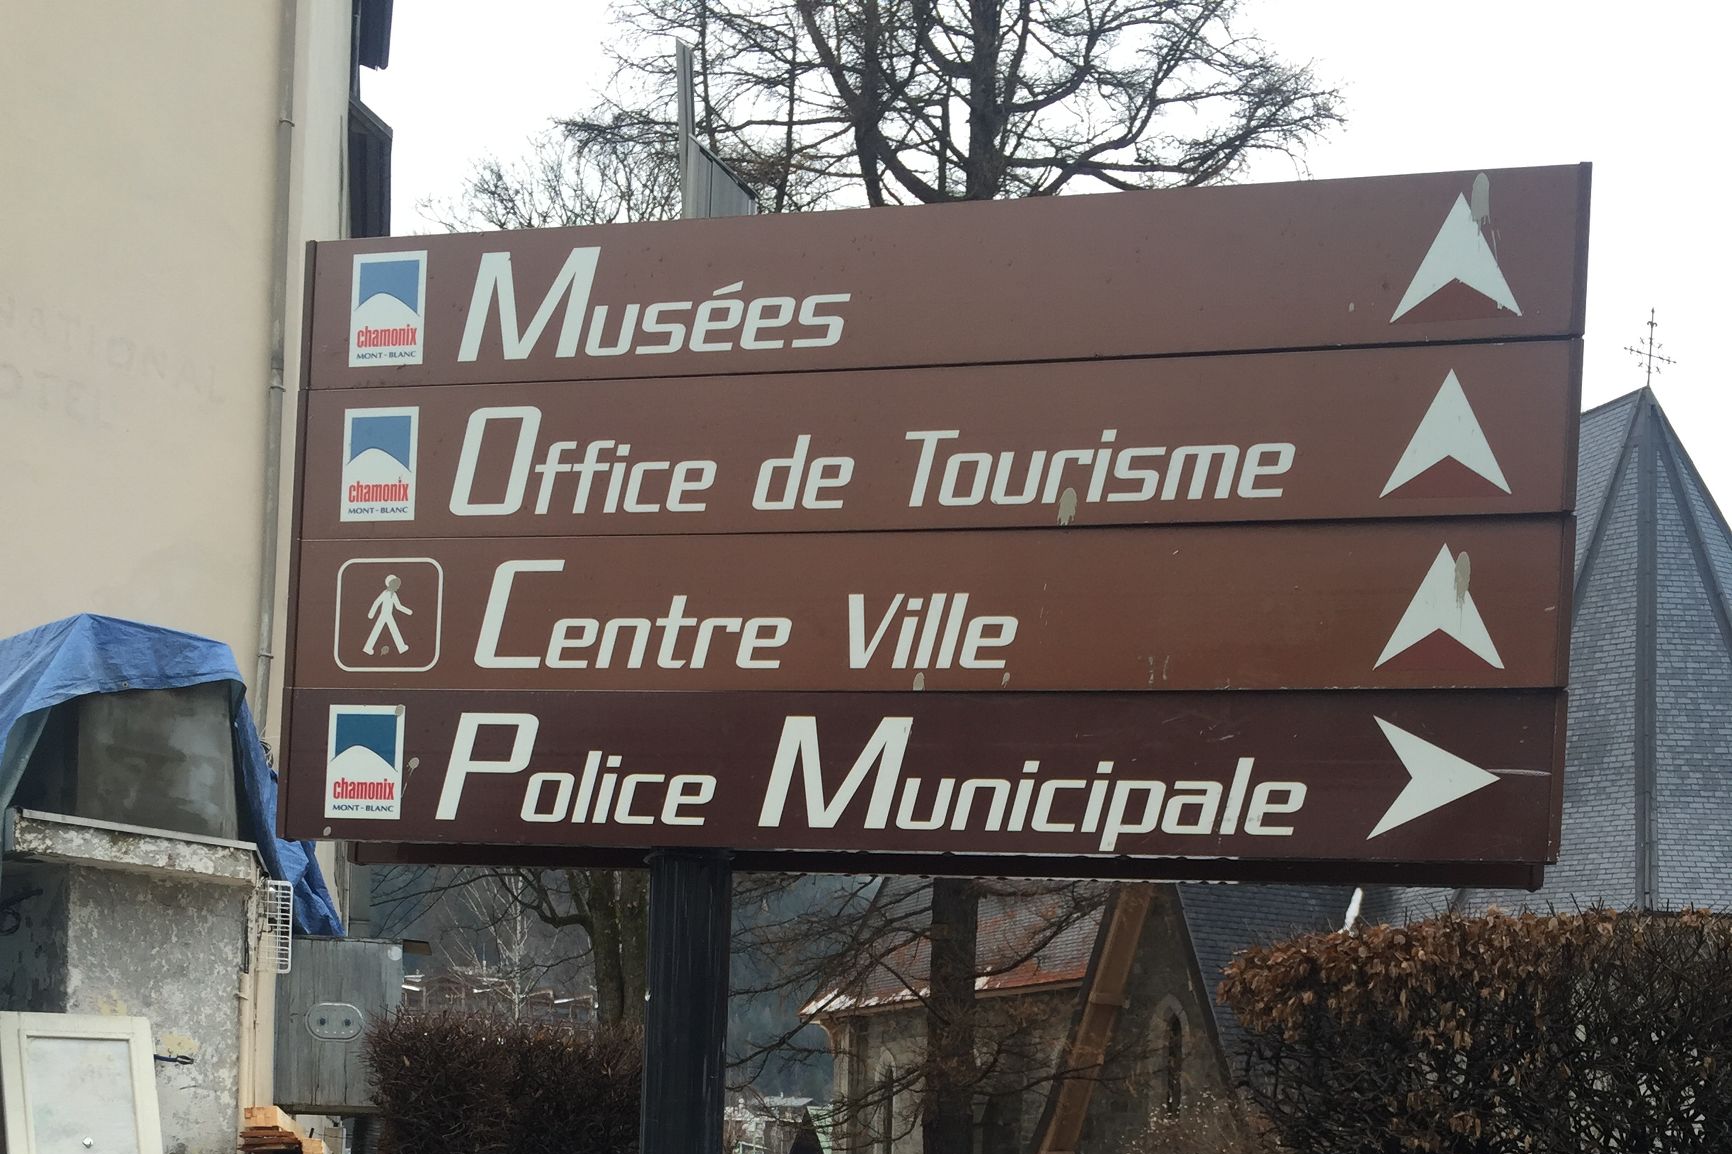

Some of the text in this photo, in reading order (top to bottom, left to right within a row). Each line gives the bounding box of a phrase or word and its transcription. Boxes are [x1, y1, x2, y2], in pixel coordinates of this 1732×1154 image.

[356, 324, 418, 348] chamonix
[457, 246, 851, 362] Musées
[348, 479, 409, 503] chamonix
[449, 405, 1297, 516] Office de Tourisme
[473, 559, 1019, 670] Centre Ville
[333, 777, 395, 801] chamonix
[435, 712, 1308, 852] Police Municipale
